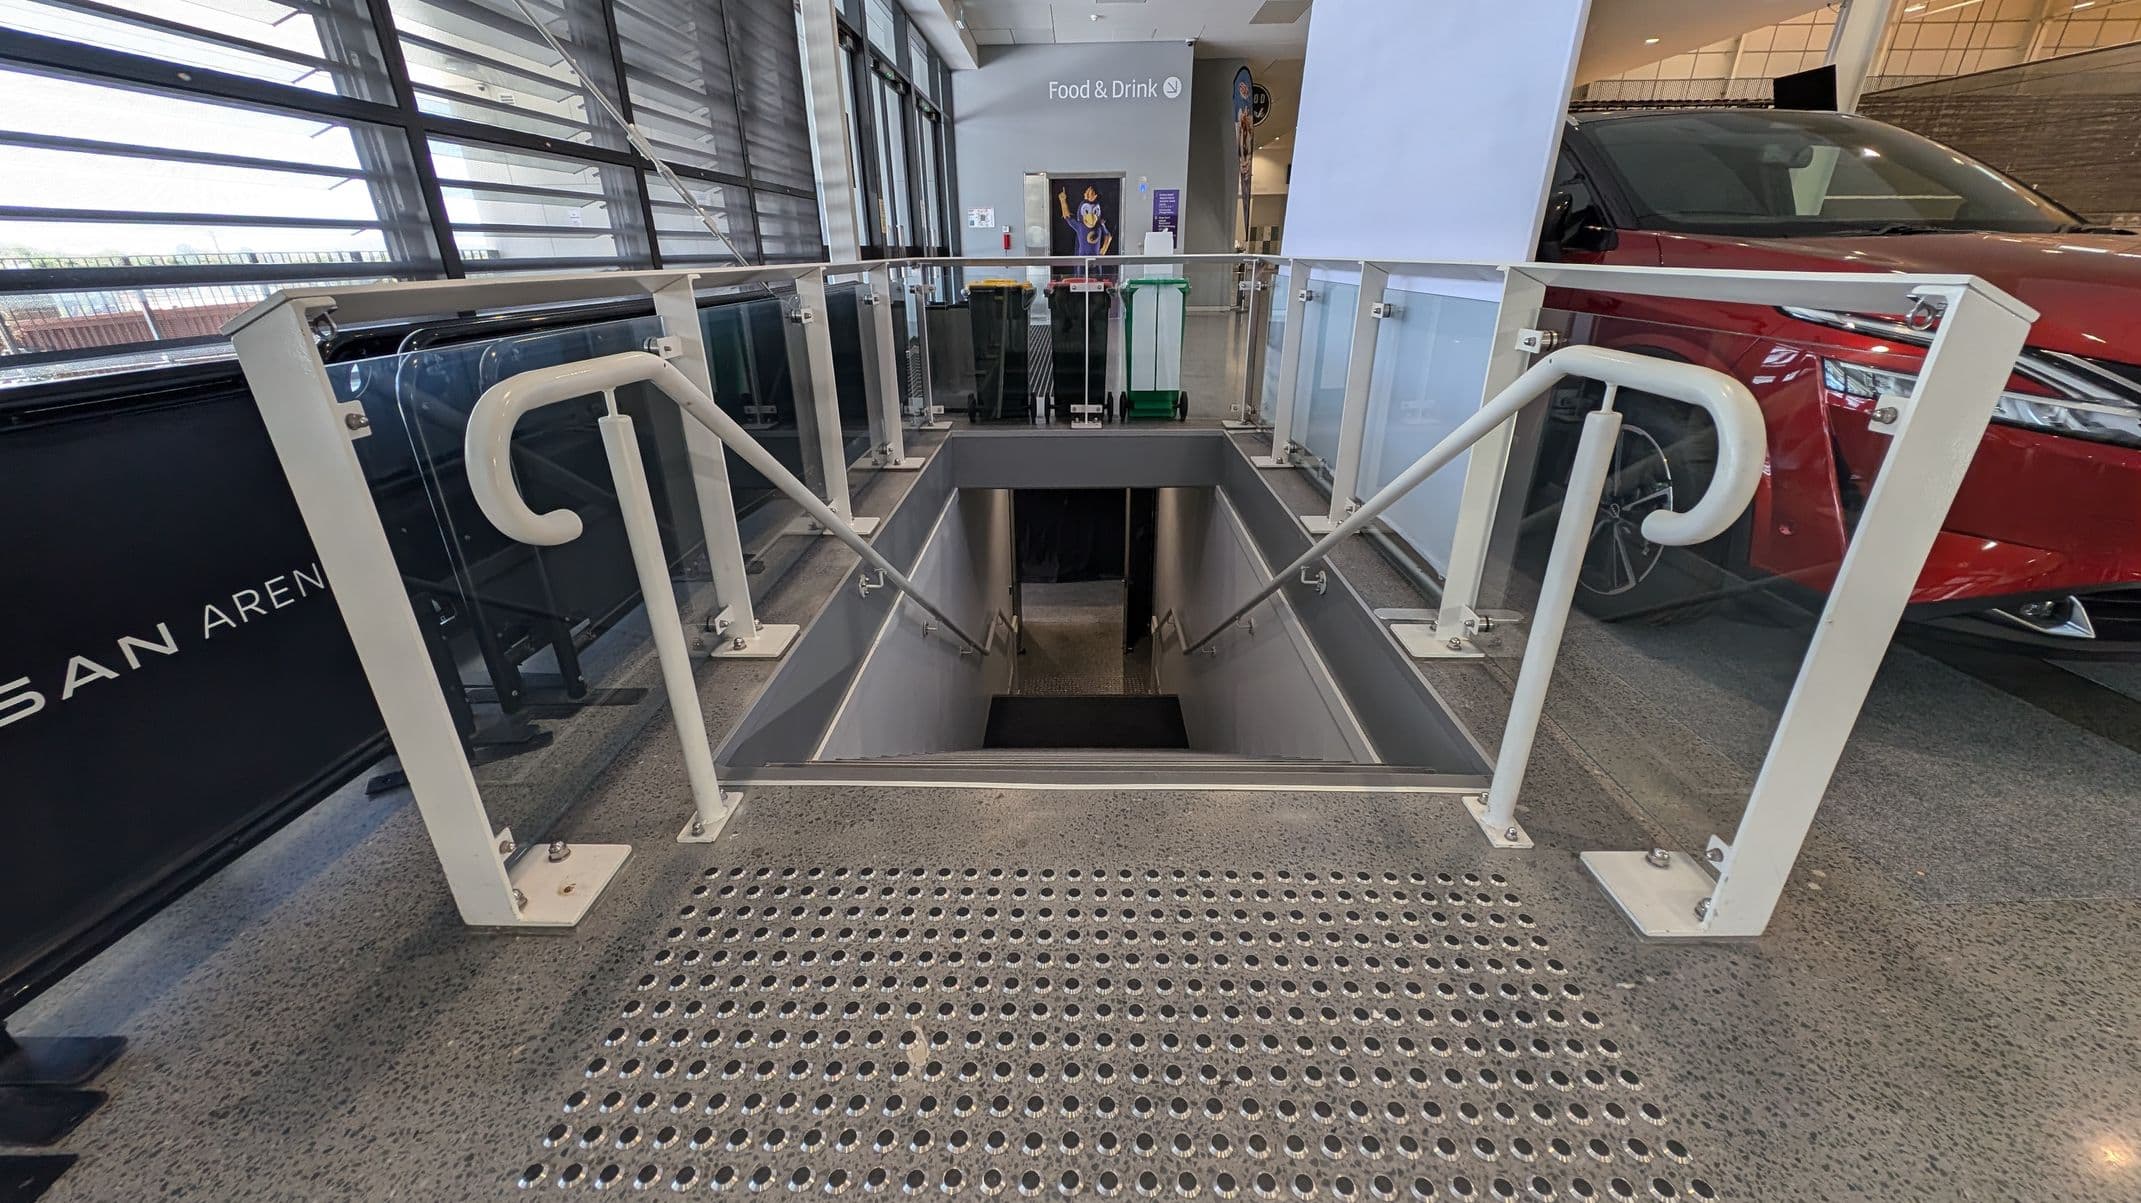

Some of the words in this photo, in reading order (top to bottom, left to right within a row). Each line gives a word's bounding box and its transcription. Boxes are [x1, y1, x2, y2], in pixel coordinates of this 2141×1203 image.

[1048, 79, 1090, 100] Food
[1094, 80, 1108, 99] &
[1112, 78, 1158, 99] Drink
[204, 562, 326, 640] AREN
